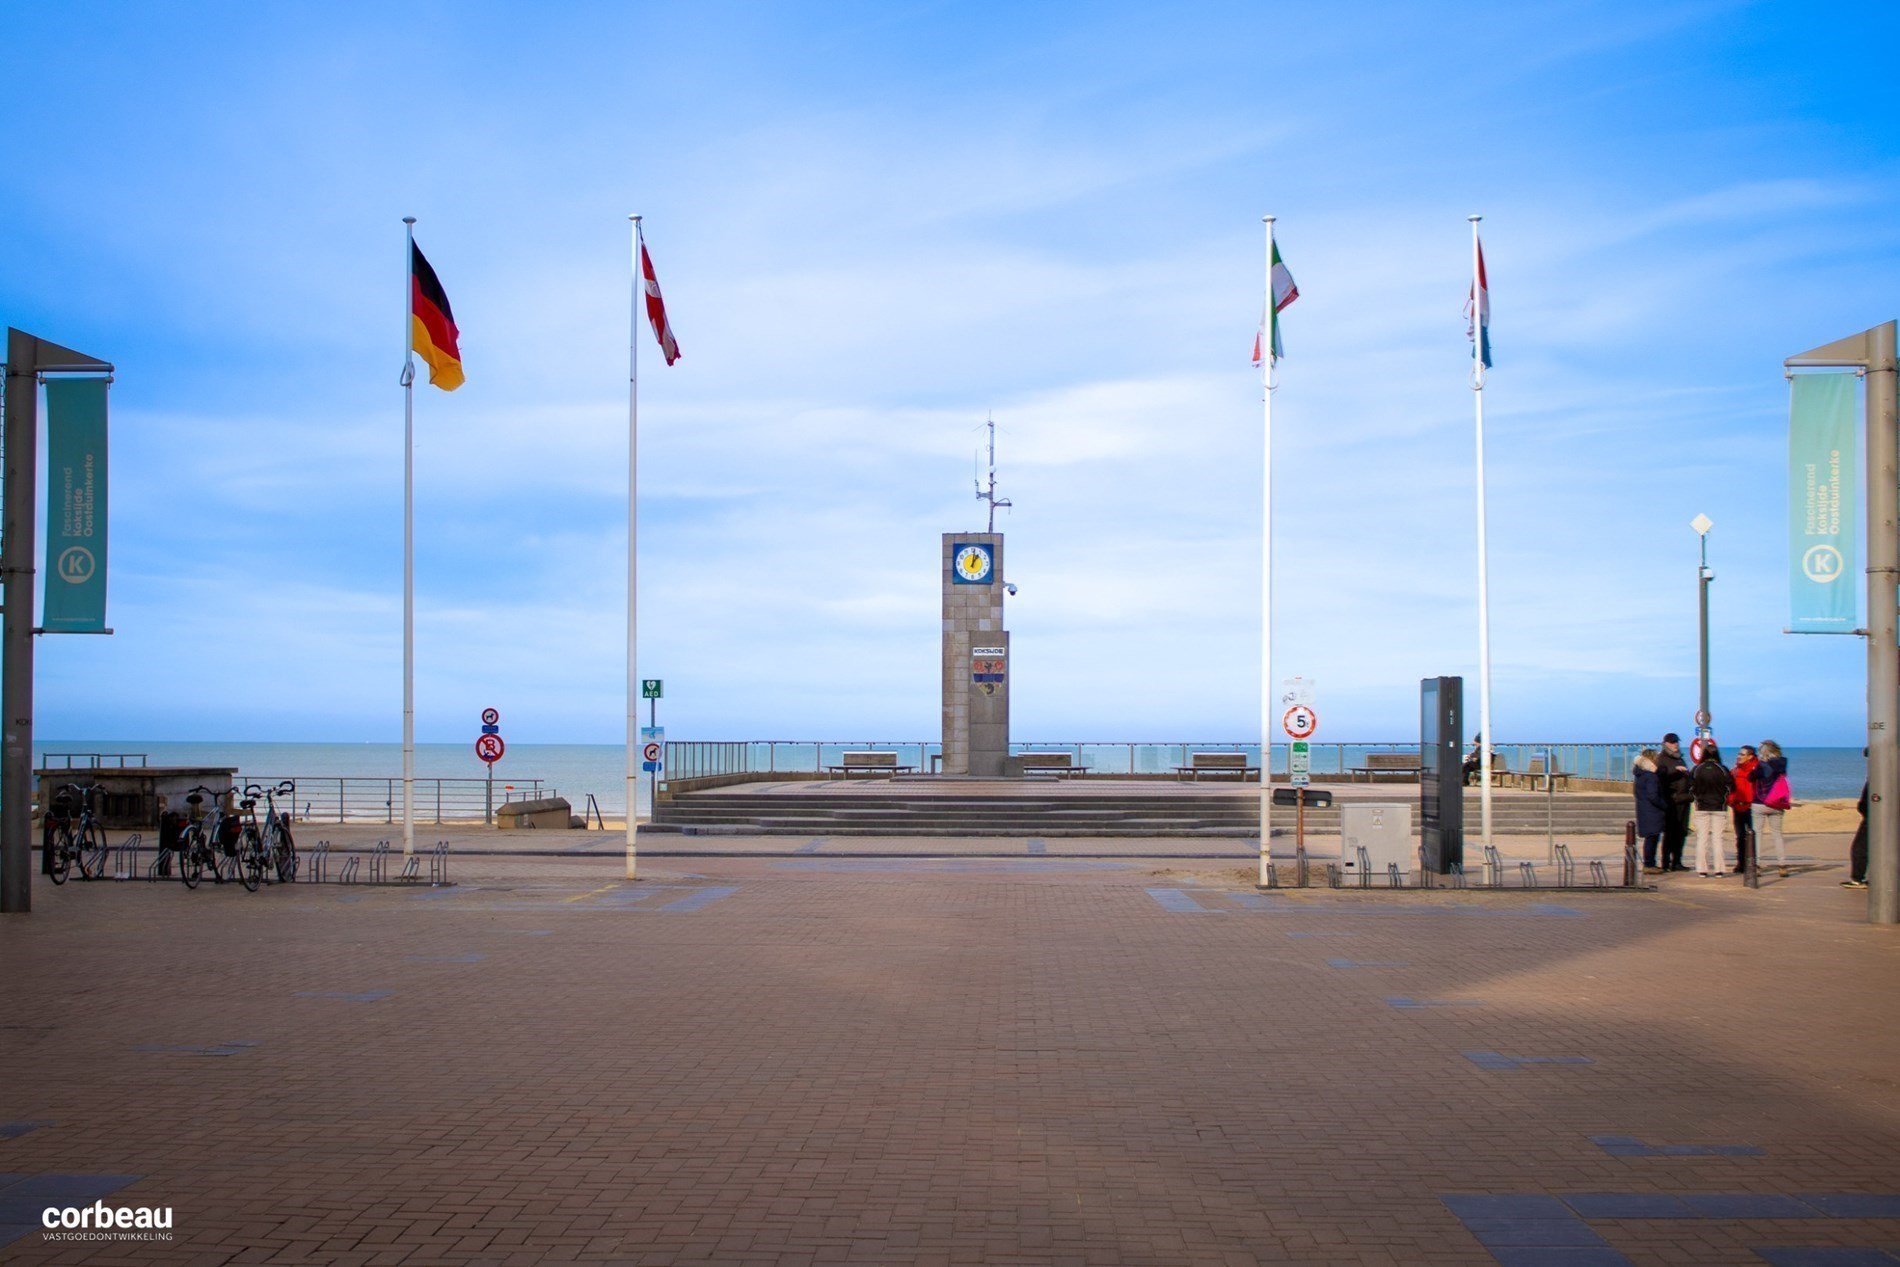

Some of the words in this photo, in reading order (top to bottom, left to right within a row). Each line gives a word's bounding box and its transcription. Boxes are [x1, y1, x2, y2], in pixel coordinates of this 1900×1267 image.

[73, 487, 84, 537] Koksijde
[84, 454, 94, 537] Oostduinkerke
[1817, 484, 1828, 535] Koksijde
[1829, 450, 1840, 535] Oostduinkerke
[68, 555, 84, 574] K
[1814, 553, 1831, 573] K
